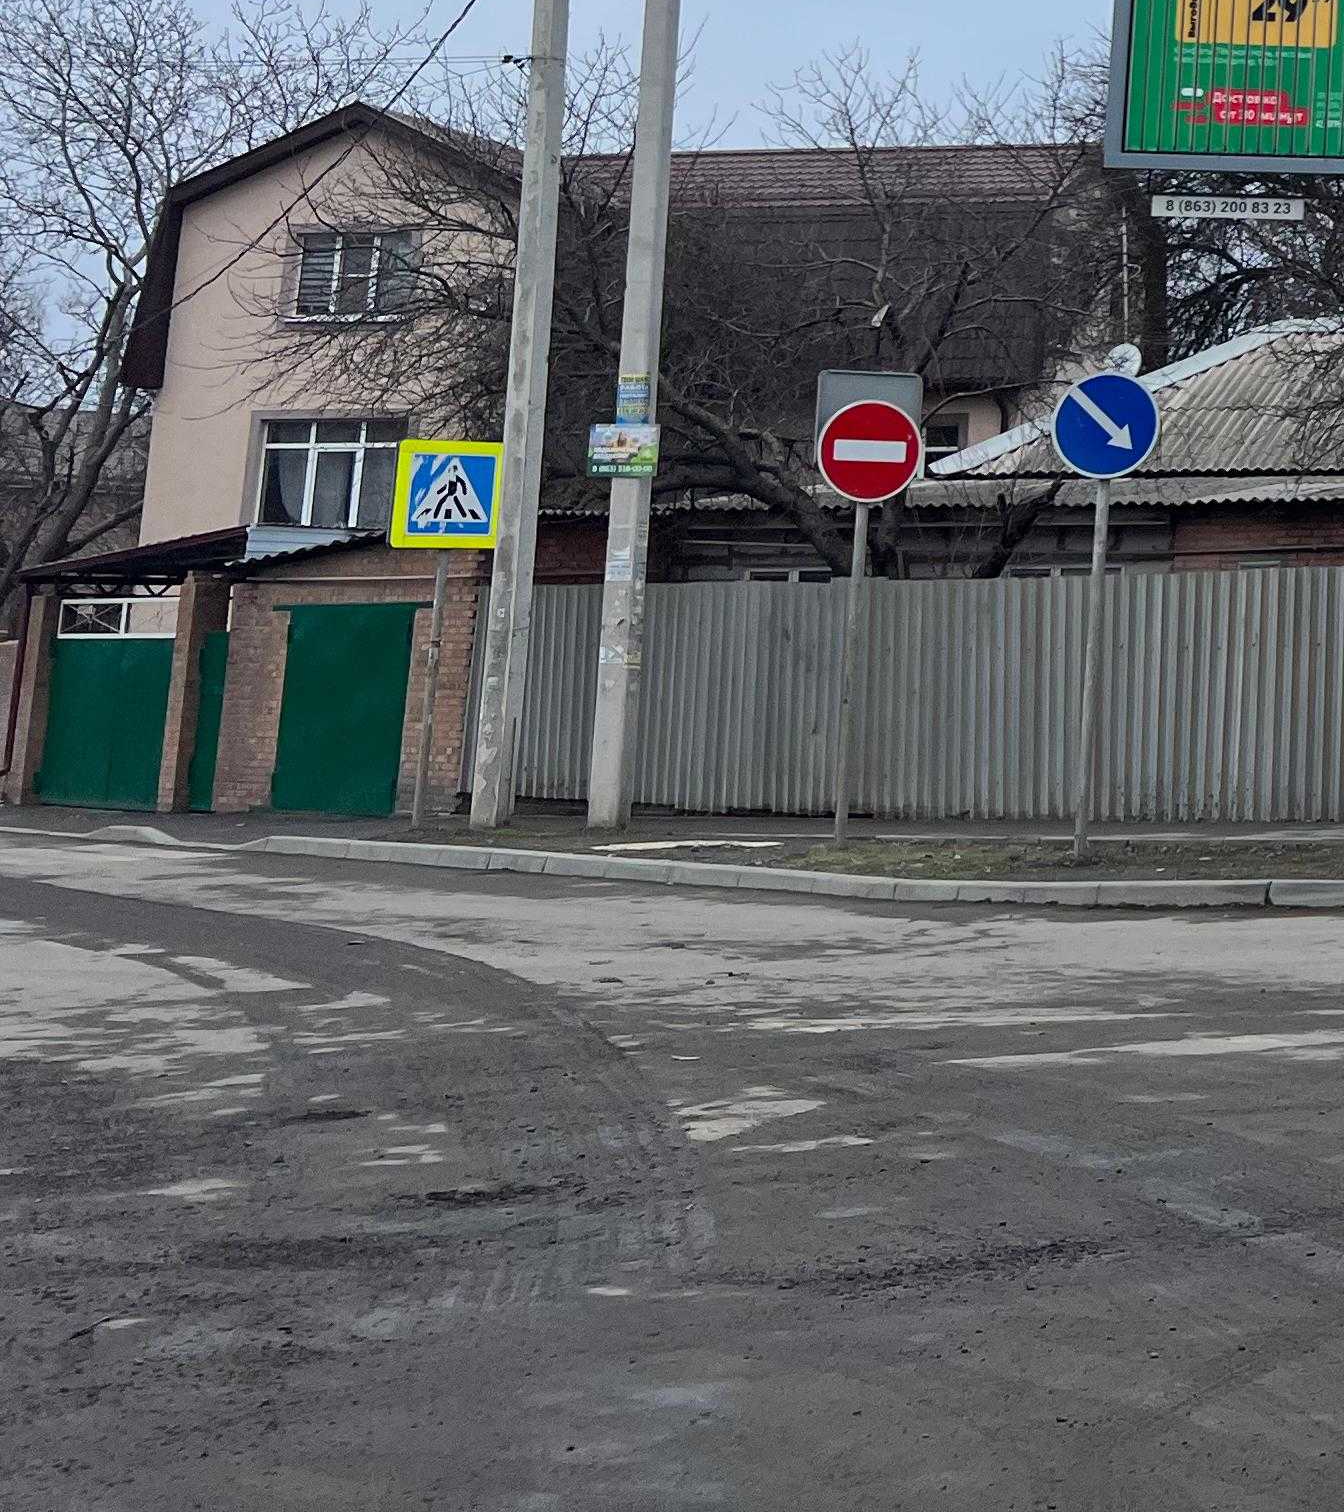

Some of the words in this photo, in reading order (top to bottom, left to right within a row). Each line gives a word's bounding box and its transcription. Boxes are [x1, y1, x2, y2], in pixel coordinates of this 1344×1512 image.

[1166, 199, 1174, 211] 8
[1178, 199, 1216, 214] (863)
[1220, 200, 1247, 213] 200
[1251, 202, 1269, 214] 83
[1273, 202, 1291, 214] 23
